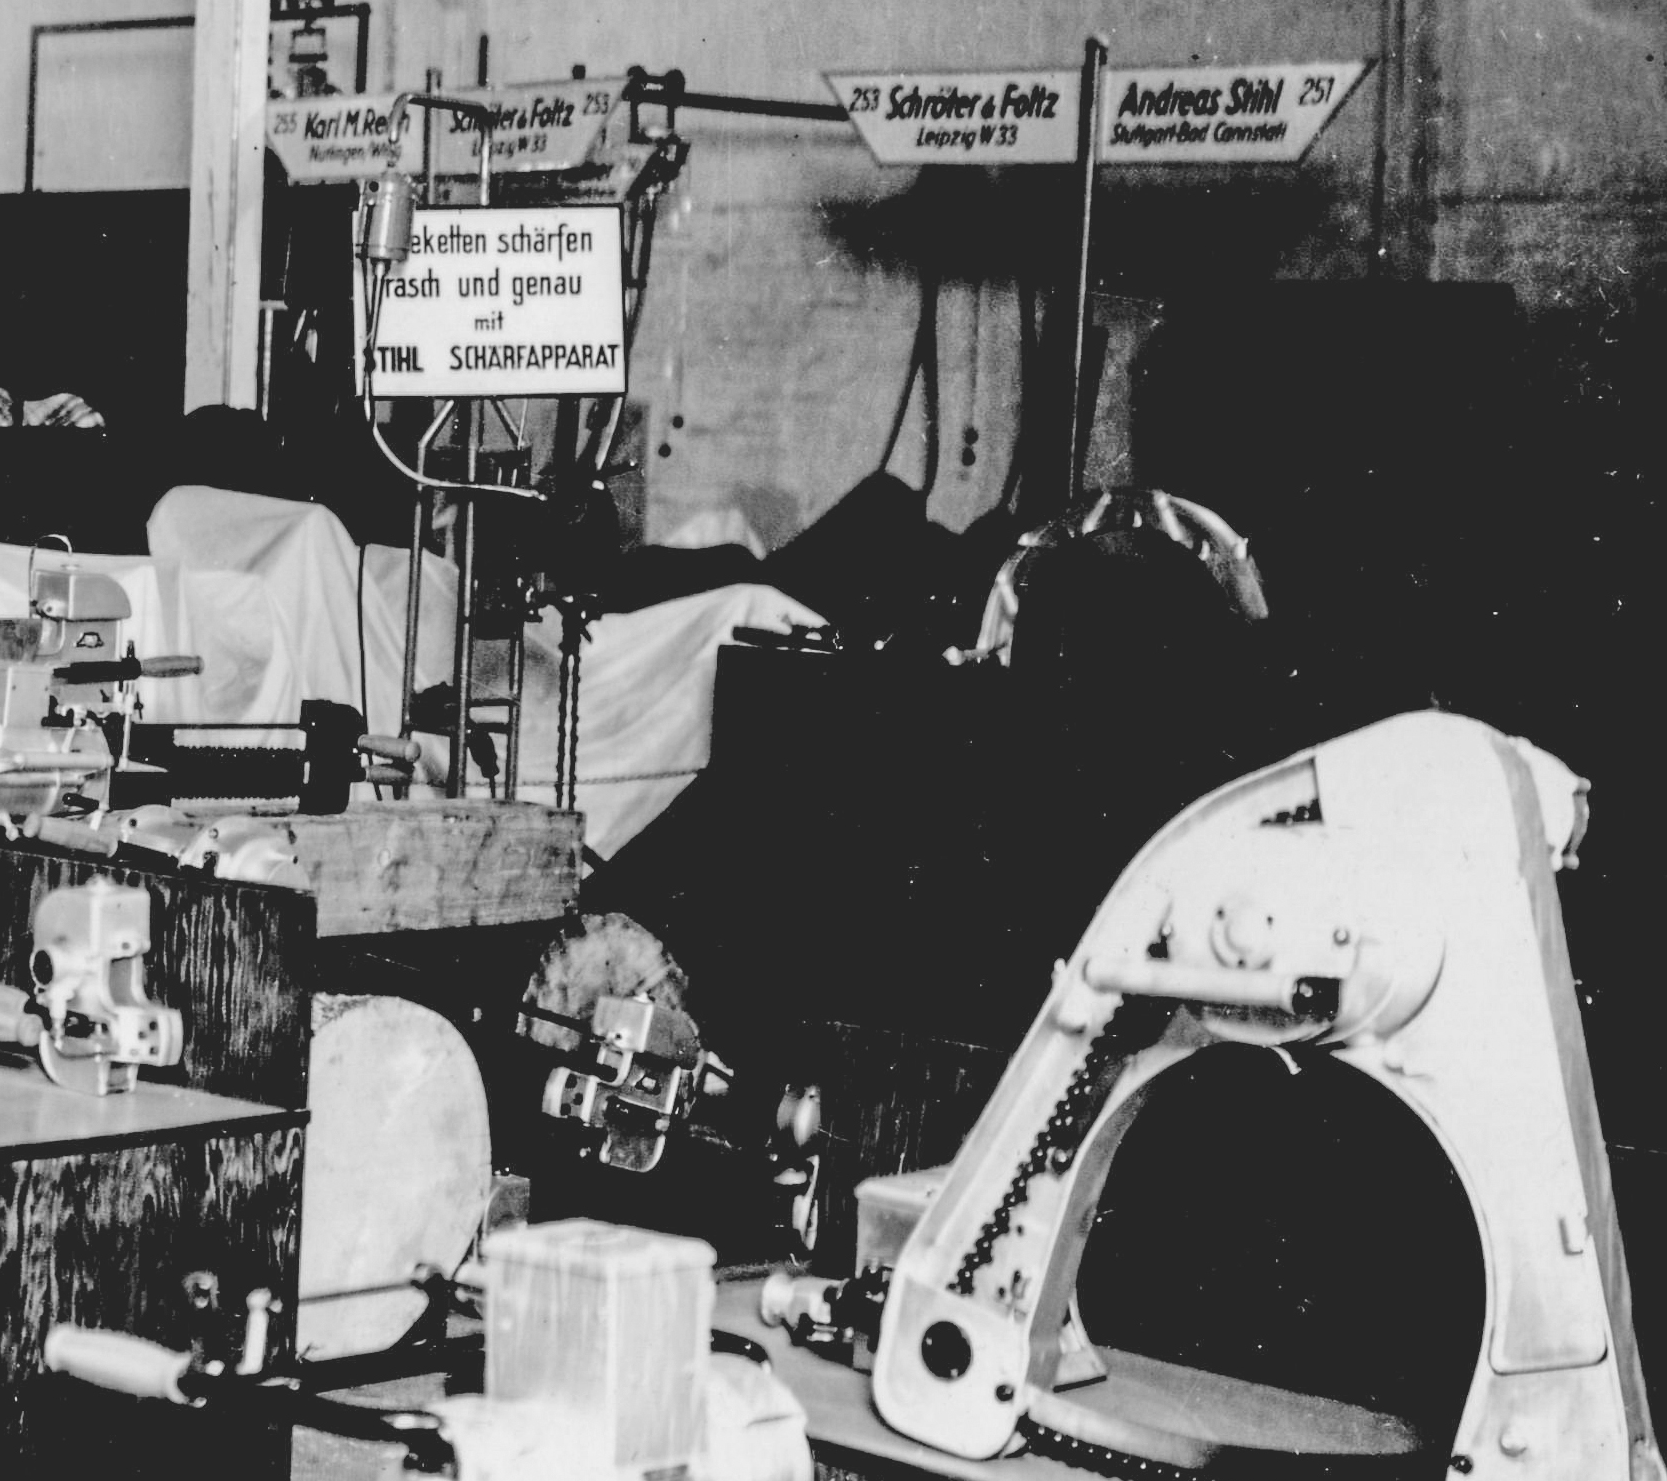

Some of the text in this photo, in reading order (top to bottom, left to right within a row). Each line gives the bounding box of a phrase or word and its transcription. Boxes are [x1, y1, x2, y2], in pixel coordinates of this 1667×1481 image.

[530, 97, 575, 128] Foltz
[583, 93, 610, 116] 253
[849, 87, 880, 112] 253
[886, 84, 981, 120] Schröter
[1000, 83, 1060, 119] Foltz
[1118, 76, 1335, 118] Andreas Stihl 251
[304, 110, 342, 139] Karl
[362, 108, 411, 136] Reh
[917, 124, 1019, 150] Leipzig W 33
[1213, 121, 1288, 143] Cannstatt
[410, 223, 593, 262] eketten schärfen
[385, 267, 582, 306] rasch und genau
[474, 311, 504, 331] mit
[364, 345, 424, 373] TIHL
